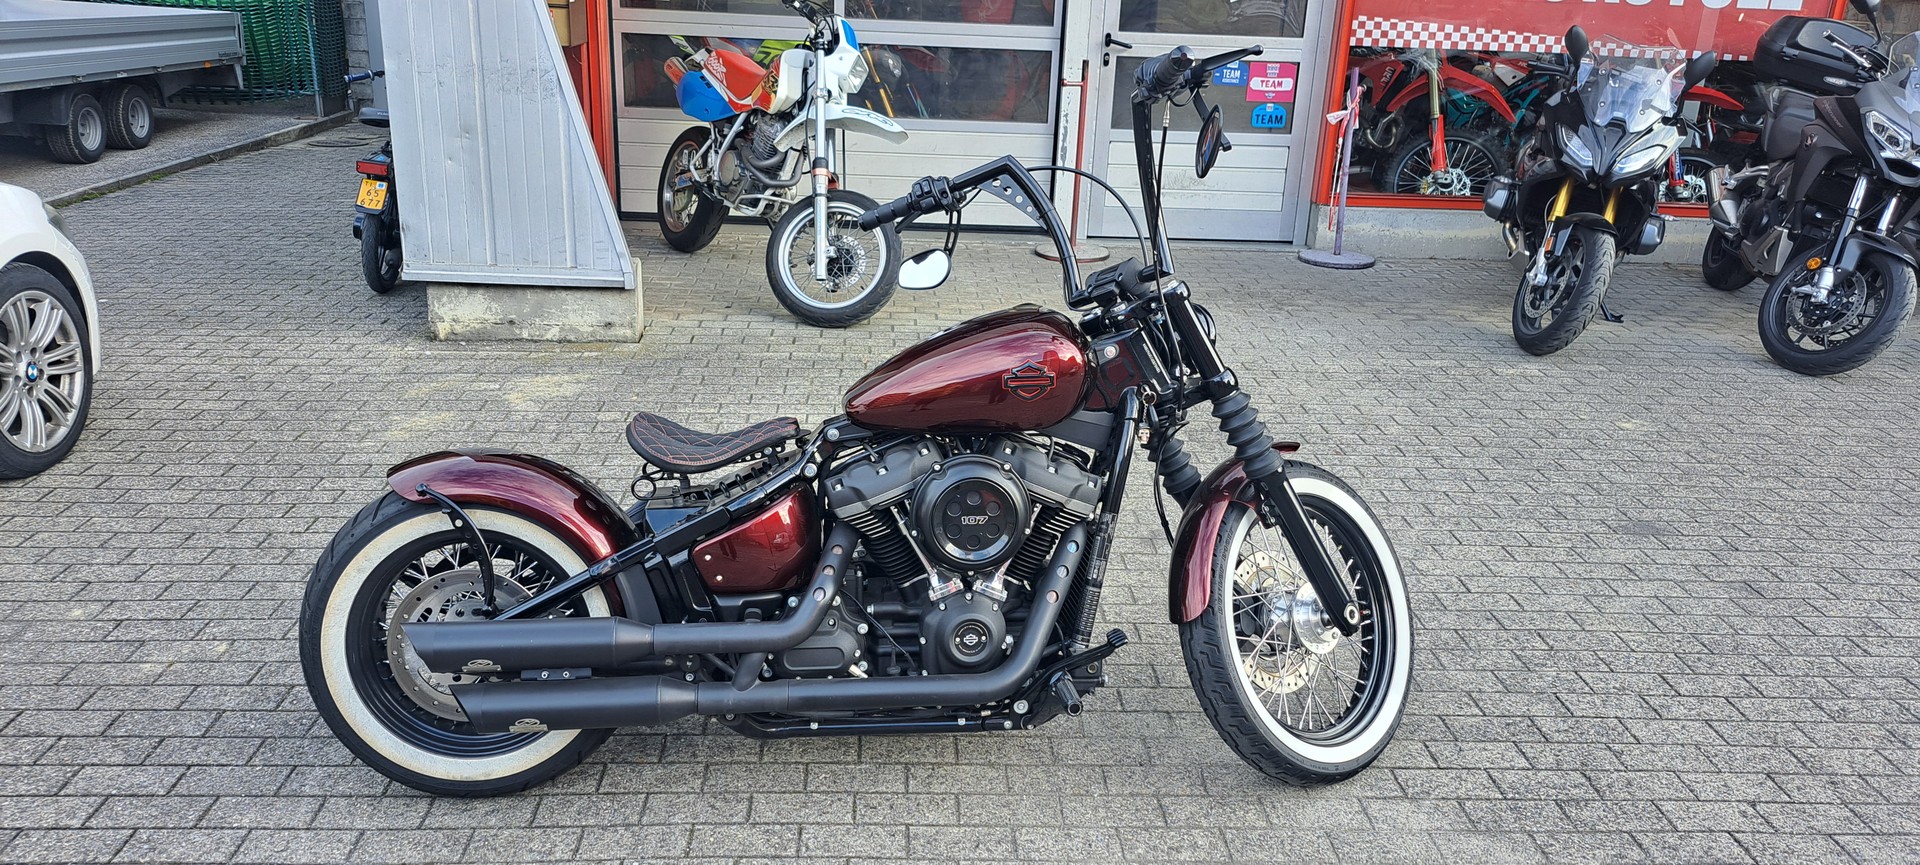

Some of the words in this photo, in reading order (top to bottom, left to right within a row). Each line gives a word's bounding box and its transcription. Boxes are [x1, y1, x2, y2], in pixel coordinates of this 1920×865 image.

[1223, 69, 1240, 78] TEAM
[1260, 80, 1283, 89] TEAM
[1255, 114, 1283, 124] TEAM
[366, 189, 380, 197] 65
[360, 198, 381, 208] 677
[961, 515, 989, 524] 107
